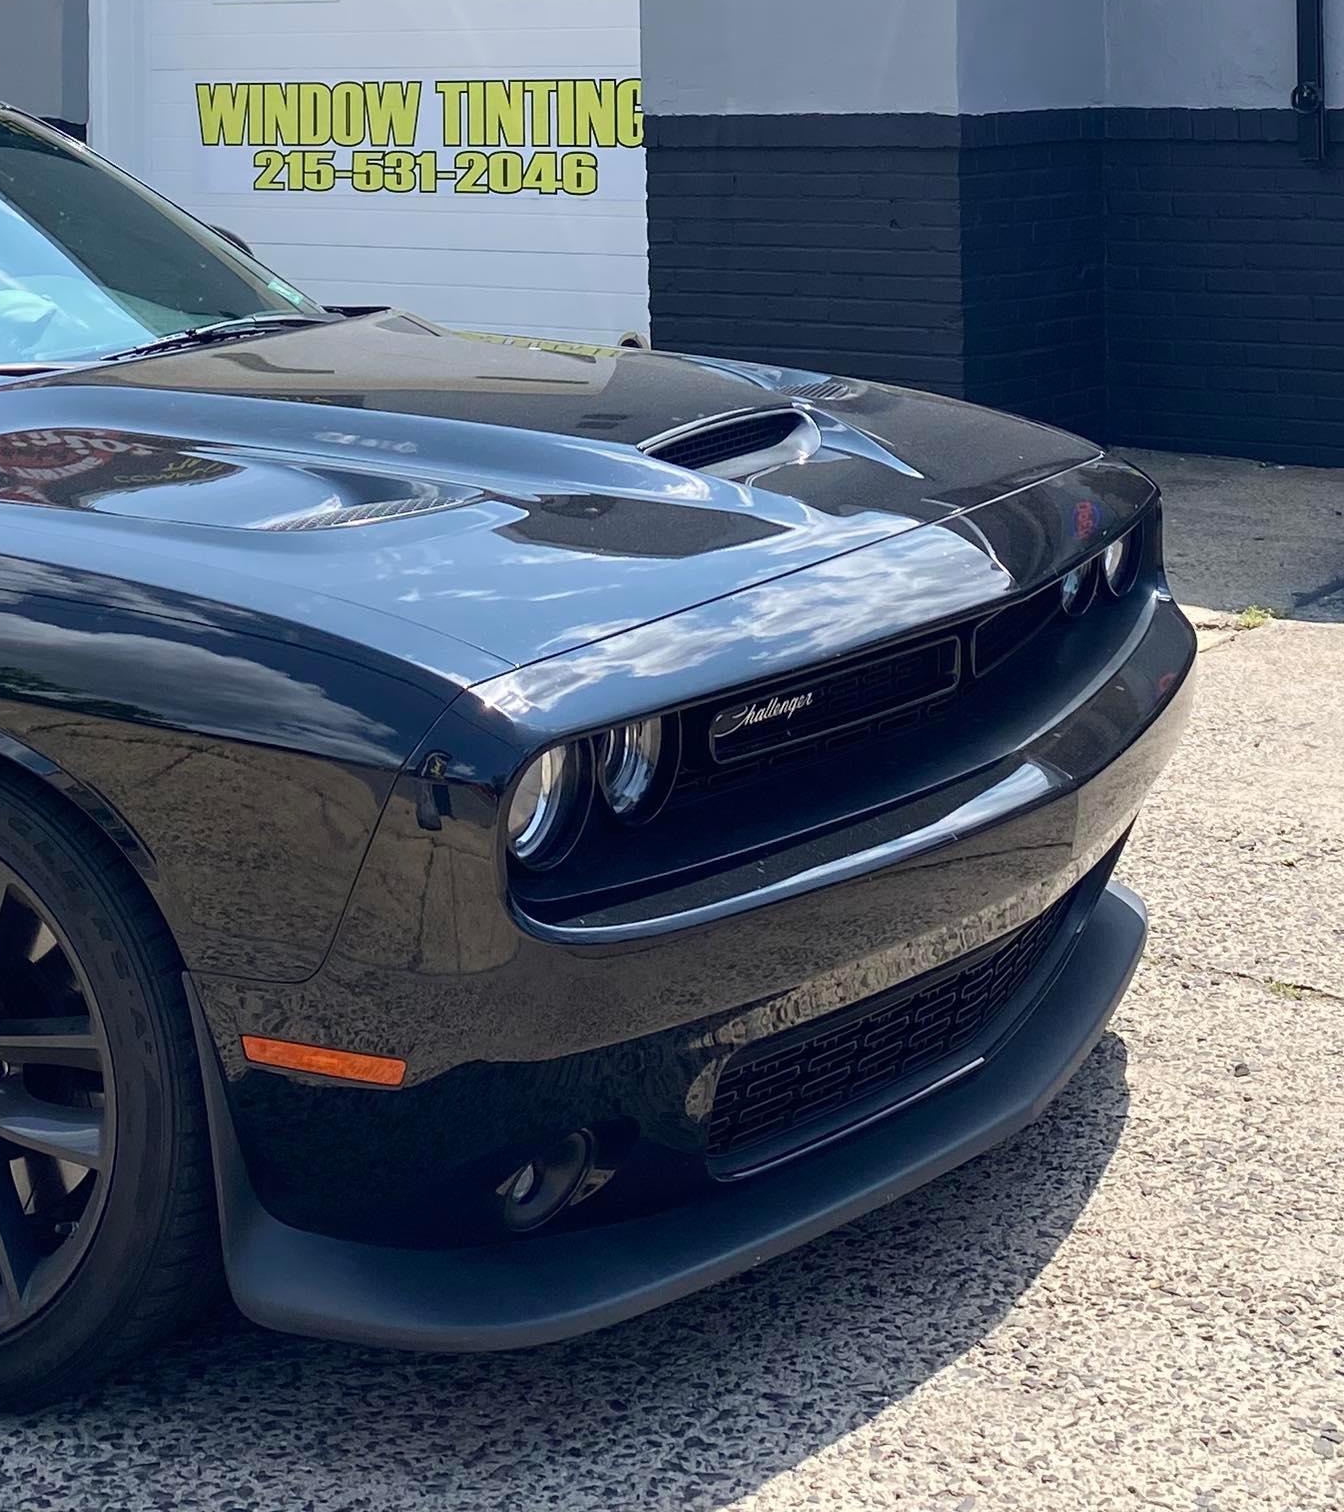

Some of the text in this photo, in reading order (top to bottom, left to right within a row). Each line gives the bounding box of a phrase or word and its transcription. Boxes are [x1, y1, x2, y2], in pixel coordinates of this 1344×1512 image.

[195, 78, 644, 148] WINDOW TINTING
[253, 150, 598, 196] 215-531-2046
[714, 691, 814, 738] Challenger
